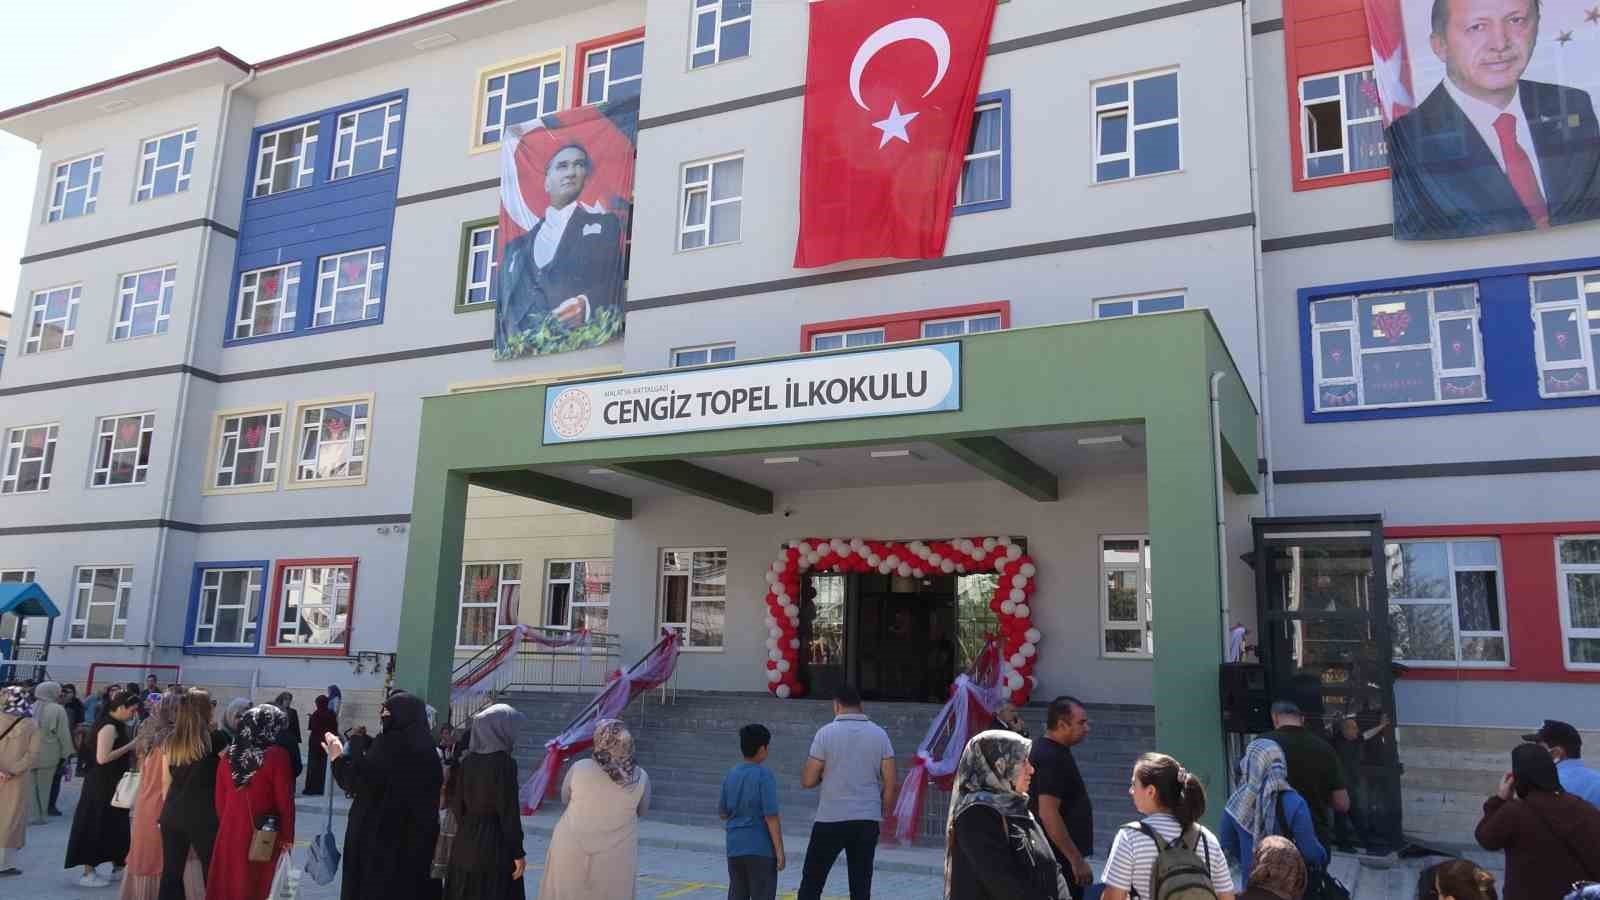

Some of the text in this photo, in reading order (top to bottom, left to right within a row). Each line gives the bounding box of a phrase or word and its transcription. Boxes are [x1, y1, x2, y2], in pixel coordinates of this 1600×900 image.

[603, 389, 692, 425] CENGİZ
[696, 385, 778, 416] TOPEL
[785, 370, 928, 409] İLKOKULU
